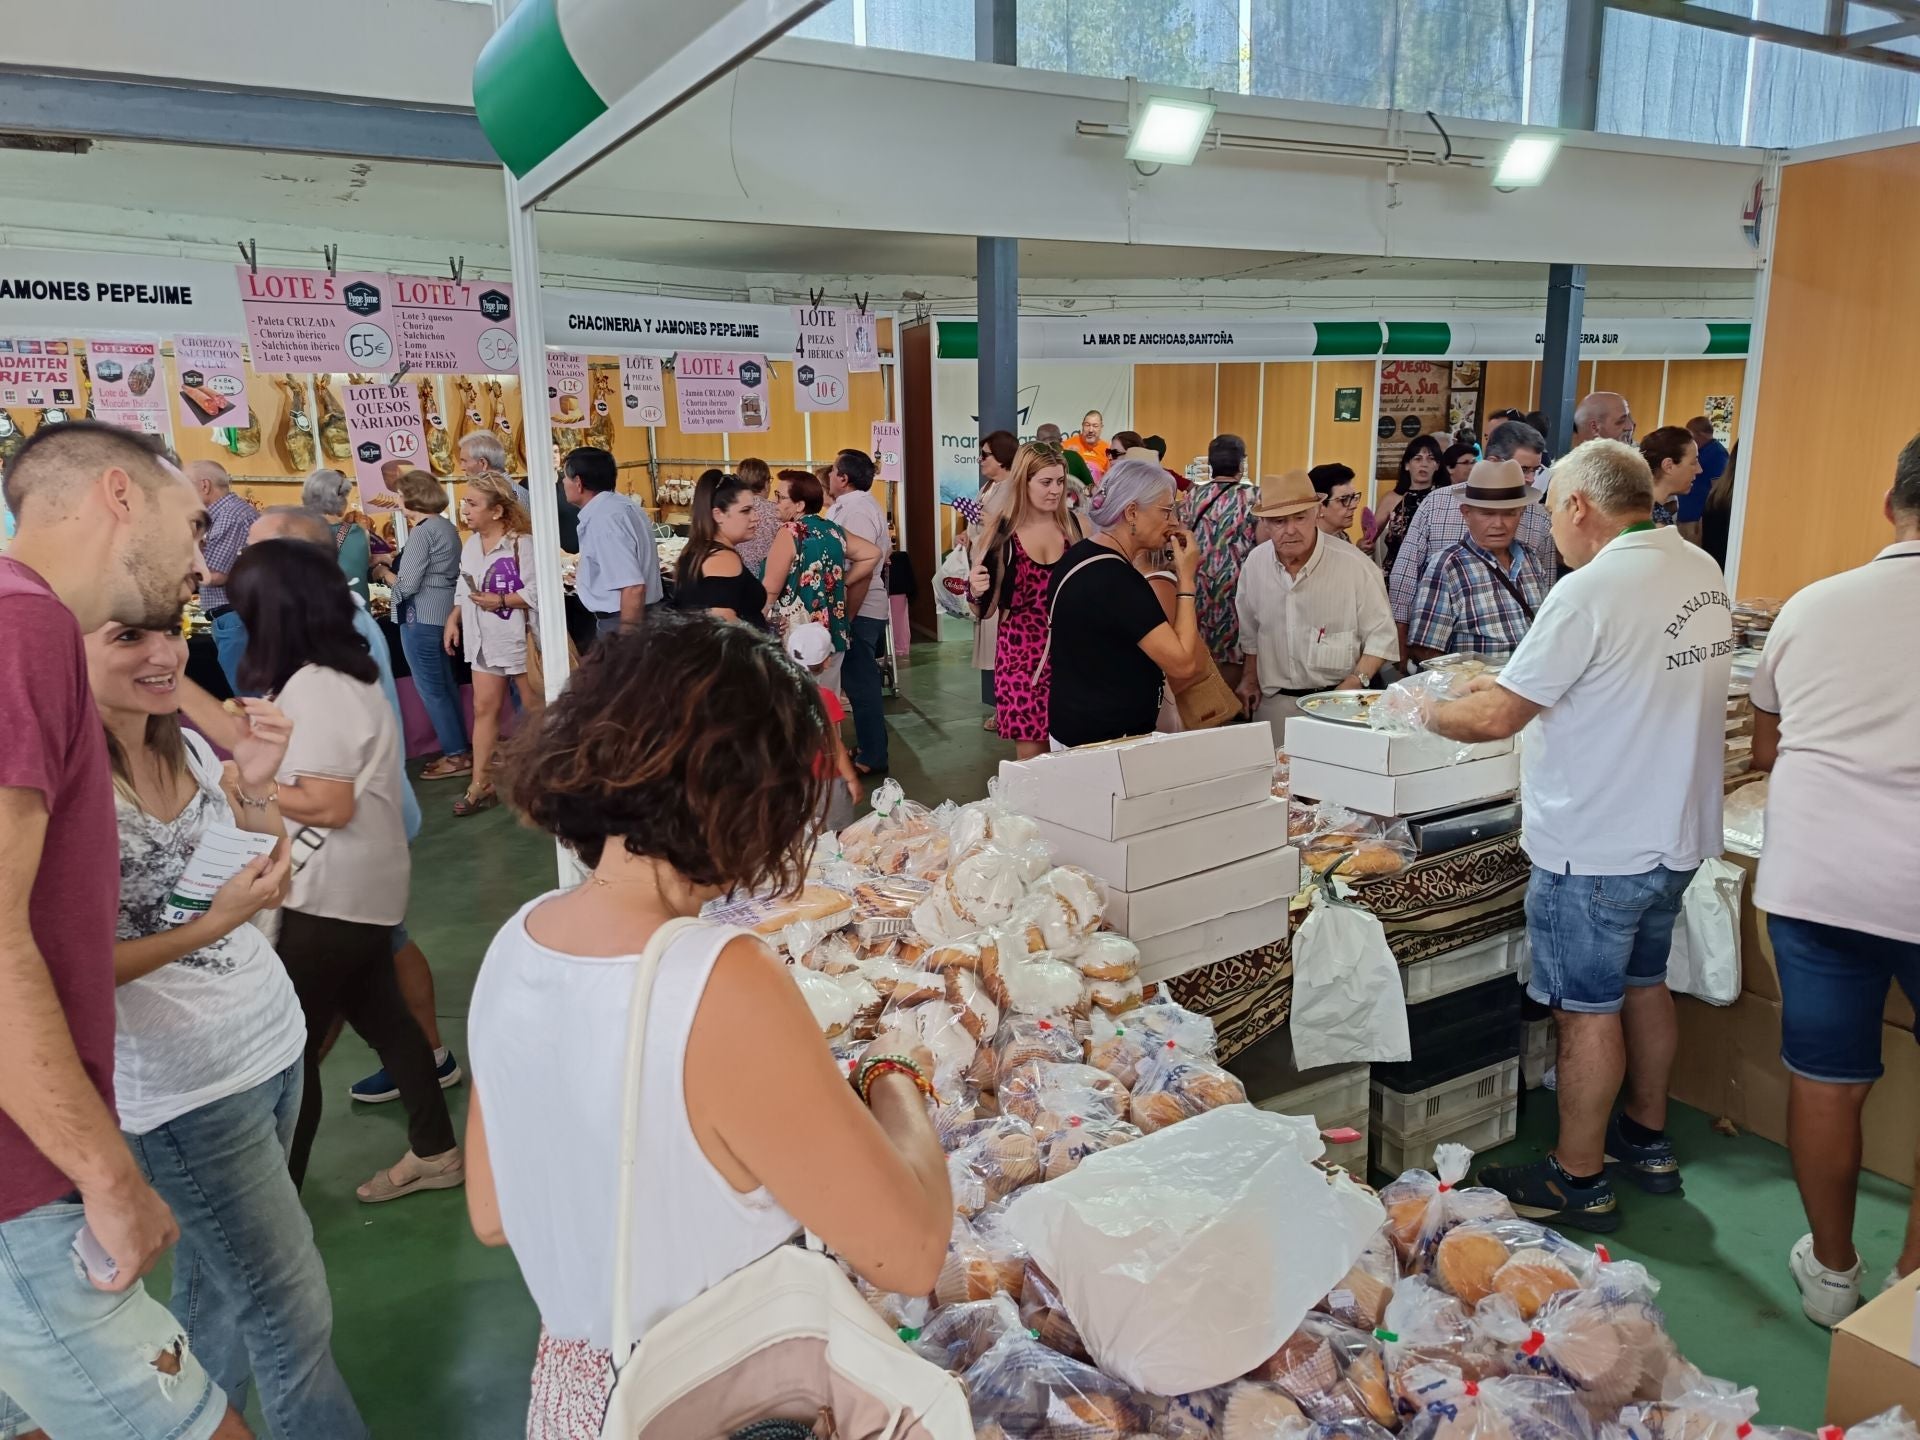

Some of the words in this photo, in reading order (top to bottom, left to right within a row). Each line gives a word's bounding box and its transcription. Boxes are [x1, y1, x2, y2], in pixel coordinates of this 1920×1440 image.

[96, 282, 192, 305] PEPEJIME
[248, 275, 316, 299] LOTE
[323, 278, 335, 300] 5
[396, 282, 456, 305] LOTE
[461, 286, 471, 306] 7
[257, 316, 285, 326] Paleta
[286, 317, 336, 328] CRUZADA
[402, 312, 420, 320] Lote
[421, 312, 426, 320] 3
[428, 314, 453, 322] quesos
[800, 309, 836, 327] LOTE
[402, 321, 434, 330] Chorizo
[568, 313, 642, 333] CHACINERIA
[643, 318, 652, 333] Y
[655, 319, 707, 336] JAMONES
[709, 322, 760, 338] PEPEJIME
[259, 329, 295, 340] Chorizo
[296, 330, 327, 340] ibérico
[403, 331, 445, 340] Salchichón
[807, 334, 835, 345] PIEZAS
[1083, 333, 1097, 345] LA
[1099, 333, 1121, 345] MAR
[1123, 333, 1136, 345] DE
[1580, 333, 1600, 344] ERRA
[1602, 333, 1619, 344] SUR
[181, 338, 226, 348] CHORIZO
[261, 340, 309, 351] Salchichón
[310, 341, 340, 351] ibérico
[350, 333, 387, 358] 65€
[404, 341, 427, 349] Lomo
[795, 332, 805, 359] 4
[264, 352, 285, 362] Lote
[286, 352, 291, 362] 3
[293, 354, 322, 364] quesos
[405, 350, 424, 359] Paté
[424, 349, 456, 359] FAISÁN
[547, 353, 569, 362] LOTE
[569, 355, 581, 363] DE
[807, 347, 844, 360] IBÉRICAS
[425, 360, 458, 369] PERDIZ
[550, 361, 580, 370] QUESOS
[626, 357, 654, 370] LOTE
[682, 357, 723, 376] LOTE
[727, 359, 734, 376] 4
[546, 368, 585, 377] VARIADOS
[563, 380, 578, 392] 12€
[623, 373, 631, 391] 4
[1380, 382, 1412, 395] ERRA
[1416, 377, 1439, 395] SUR
[99, 388, 118, 398] Lote
[118, 388, 129, 398] de
[349, 388, 388, 401] LOTE
[391, 387, 409, 399] DE
[685, 389, 704, 397] Jamón
[704, 389, 735, 397] CRUZADO
[816, 381, 828, 398] 10
[830, 381, 837, 398] €
[356, 400, 411, 418] QUESOS
[685, 399, 708, 407] Chorizo
[686, 408, 716, 416] Salchichón
[350, 414, 421, 430] VARIADOS
[687, 417, 700, 425] Lote
[705, 418, 724, 426] quesos
[873, 425, 900, 436] PALETAS
[389, 434, 416, 453] 12€
[1665, 644, 1707, 670] NIÑO
